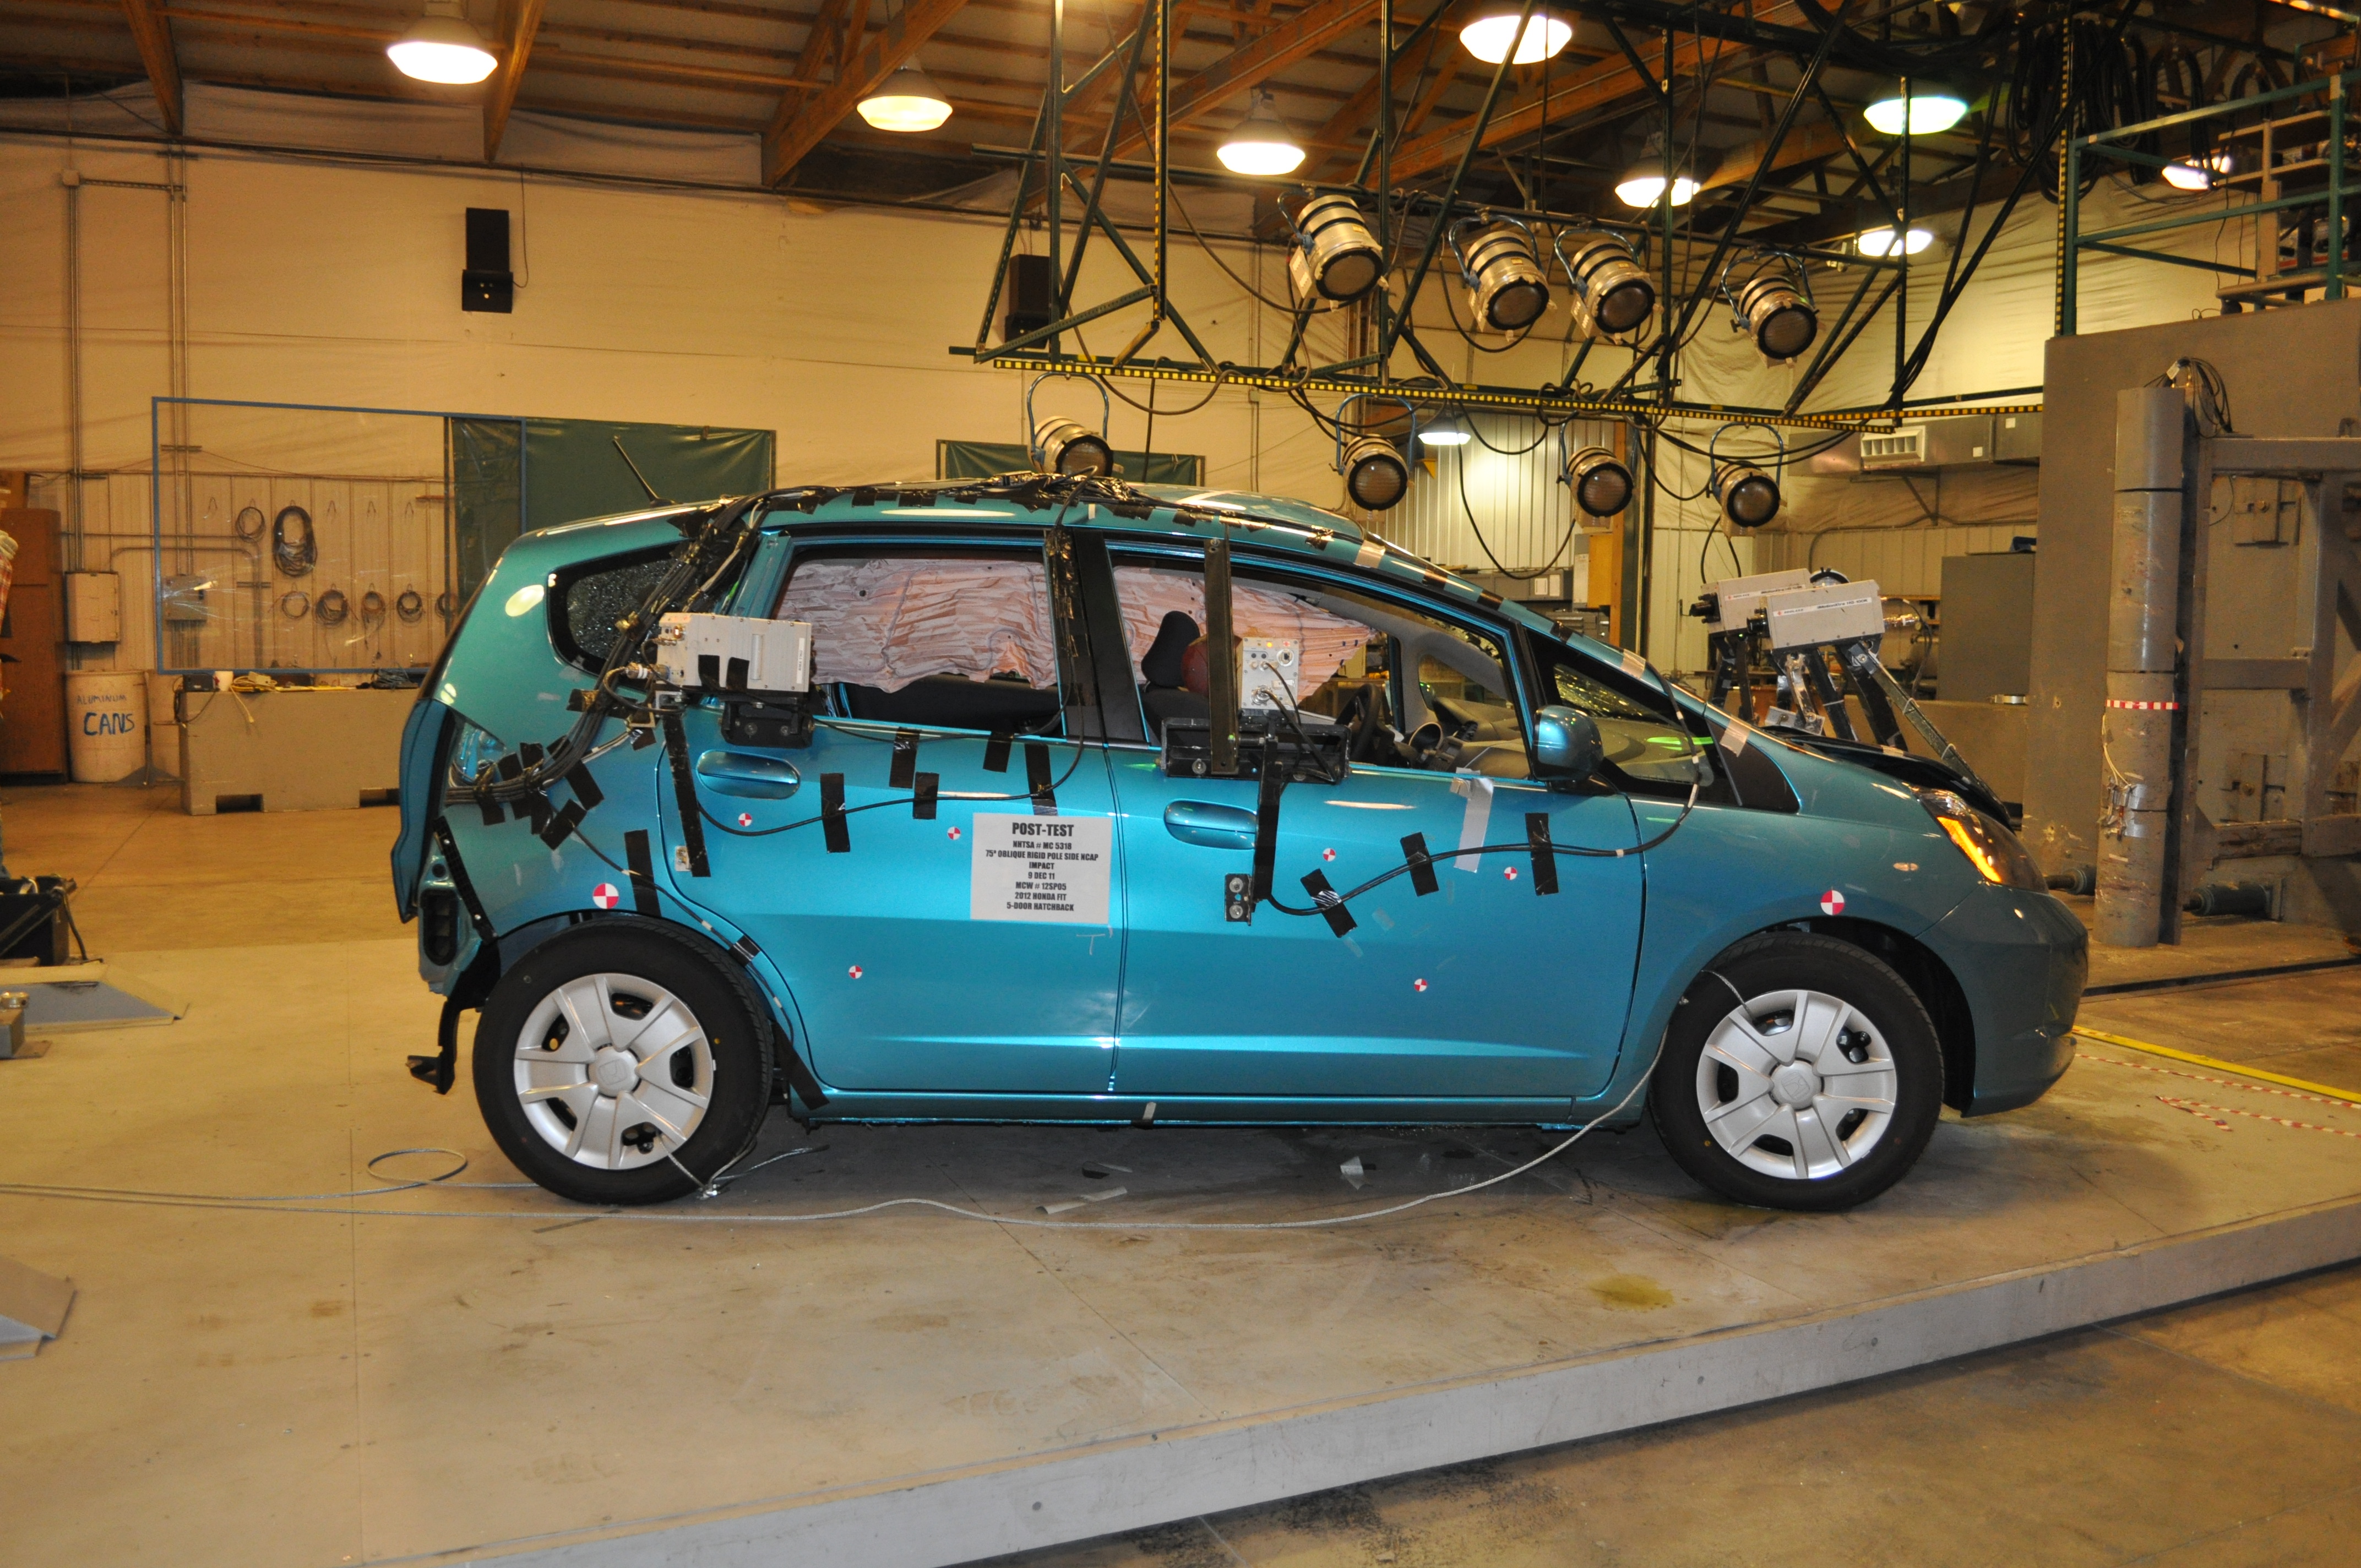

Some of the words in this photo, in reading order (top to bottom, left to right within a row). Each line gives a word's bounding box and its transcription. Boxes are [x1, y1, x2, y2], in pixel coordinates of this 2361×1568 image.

[77, 694, 127, 704] ALUMINUM
[83, 712, 134, 736] CANS
[1012, 822, 1074, 837] POST-TEST
[1013, 840, 1035, 848] NHTSA
[998, 850, 1026, 858] OBLIQUE
[1033, 903, 1074, 911] HATCHBACK
